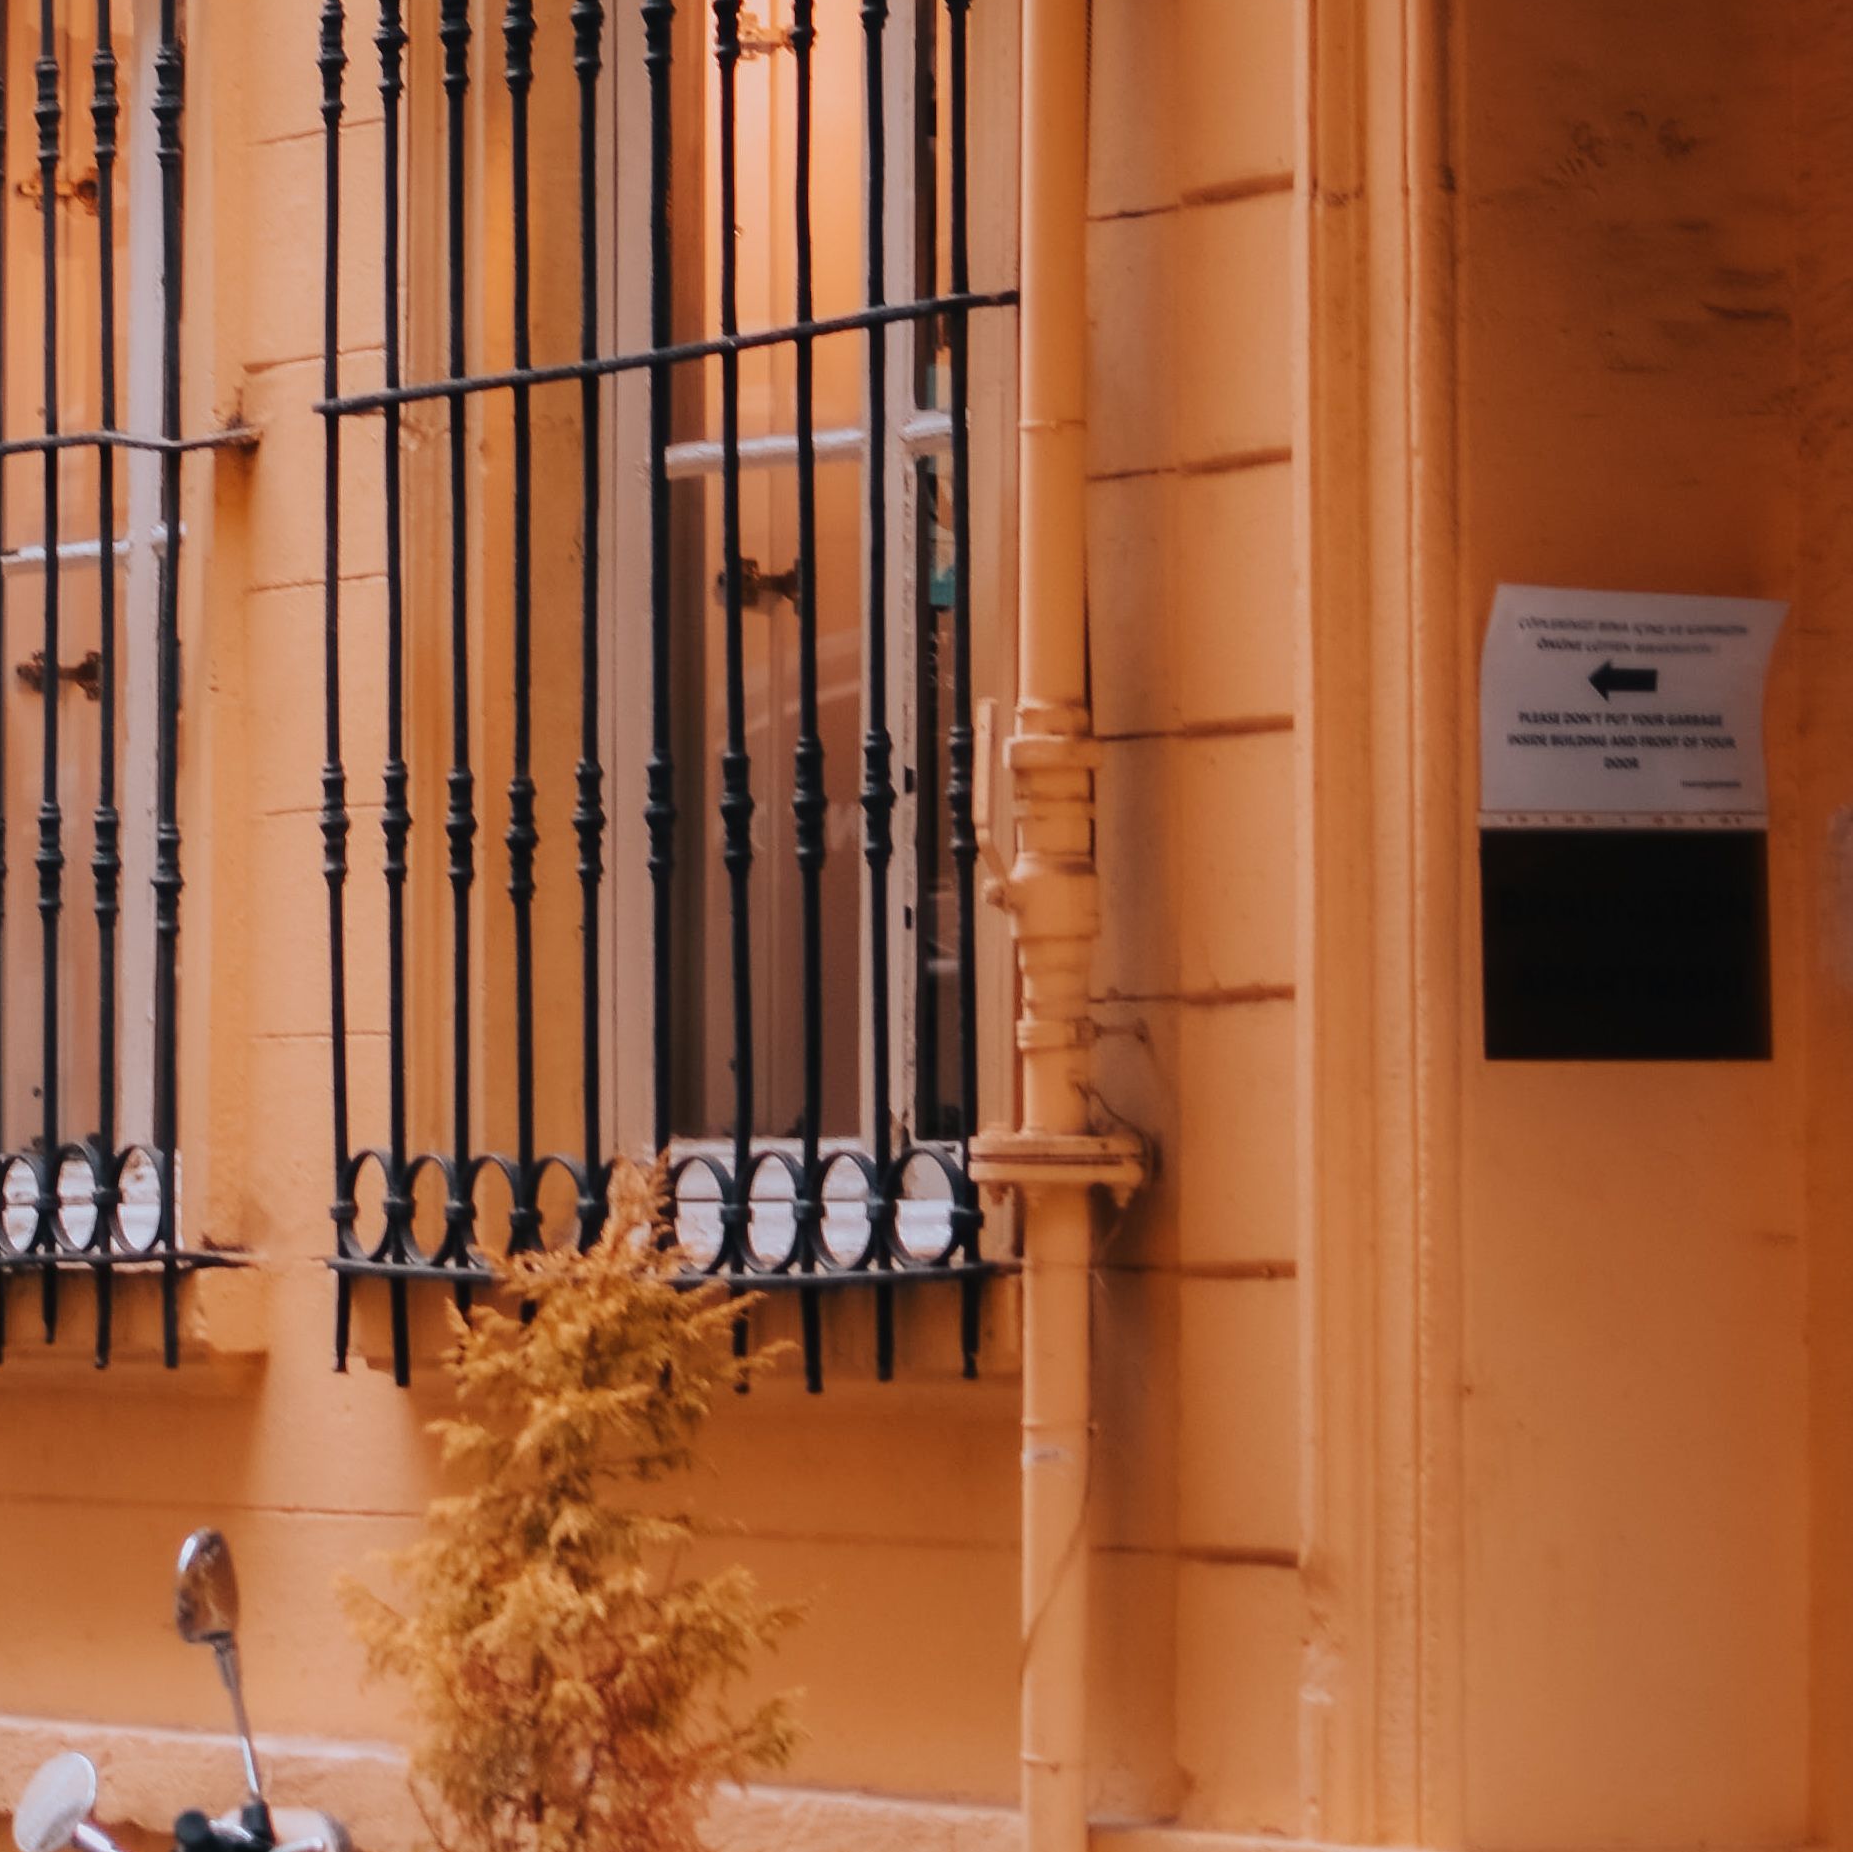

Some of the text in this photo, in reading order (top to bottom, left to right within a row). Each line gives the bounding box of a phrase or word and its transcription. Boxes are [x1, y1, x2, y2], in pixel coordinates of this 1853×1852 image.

[1631, 713, 1665, 726] YOUR
[1610, 735, 1638, 747] AND
[1700, 736, 1737, 749] YOUR
